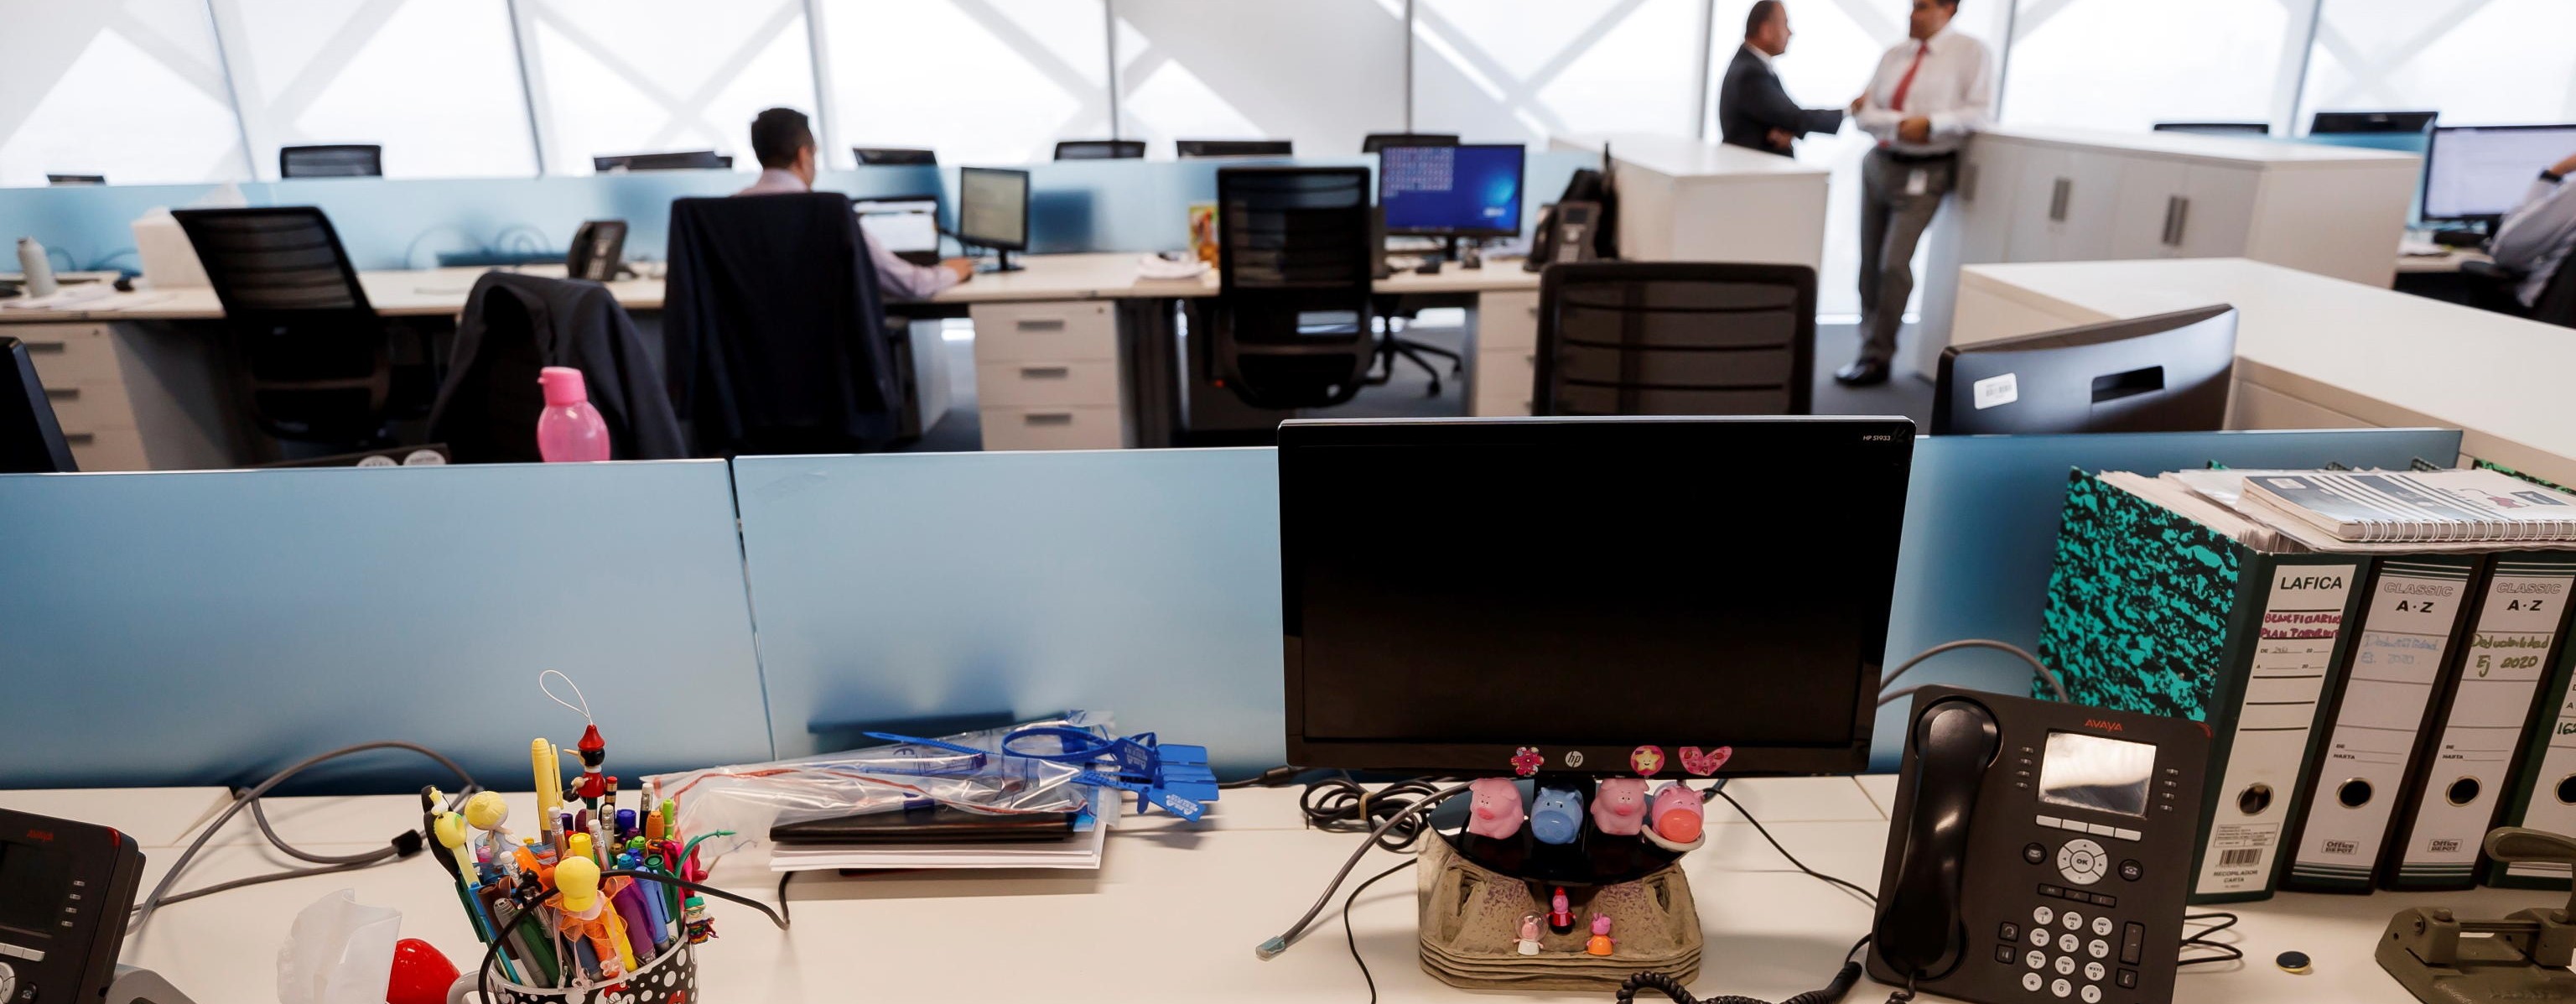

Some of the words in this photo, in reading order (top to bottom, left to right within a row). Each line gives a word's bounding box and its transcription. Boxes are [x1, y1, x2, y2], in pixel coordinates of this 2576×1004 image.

[2280, 576, 2342, 590] LAFICA
[2384, 582, 2454, 596] CLASSIC
[2496, 582, 2562, 594] CLASSIC
[2500, 656, 2538, 668] 2020
[2085, 719, 2123, 732] AVAYA
